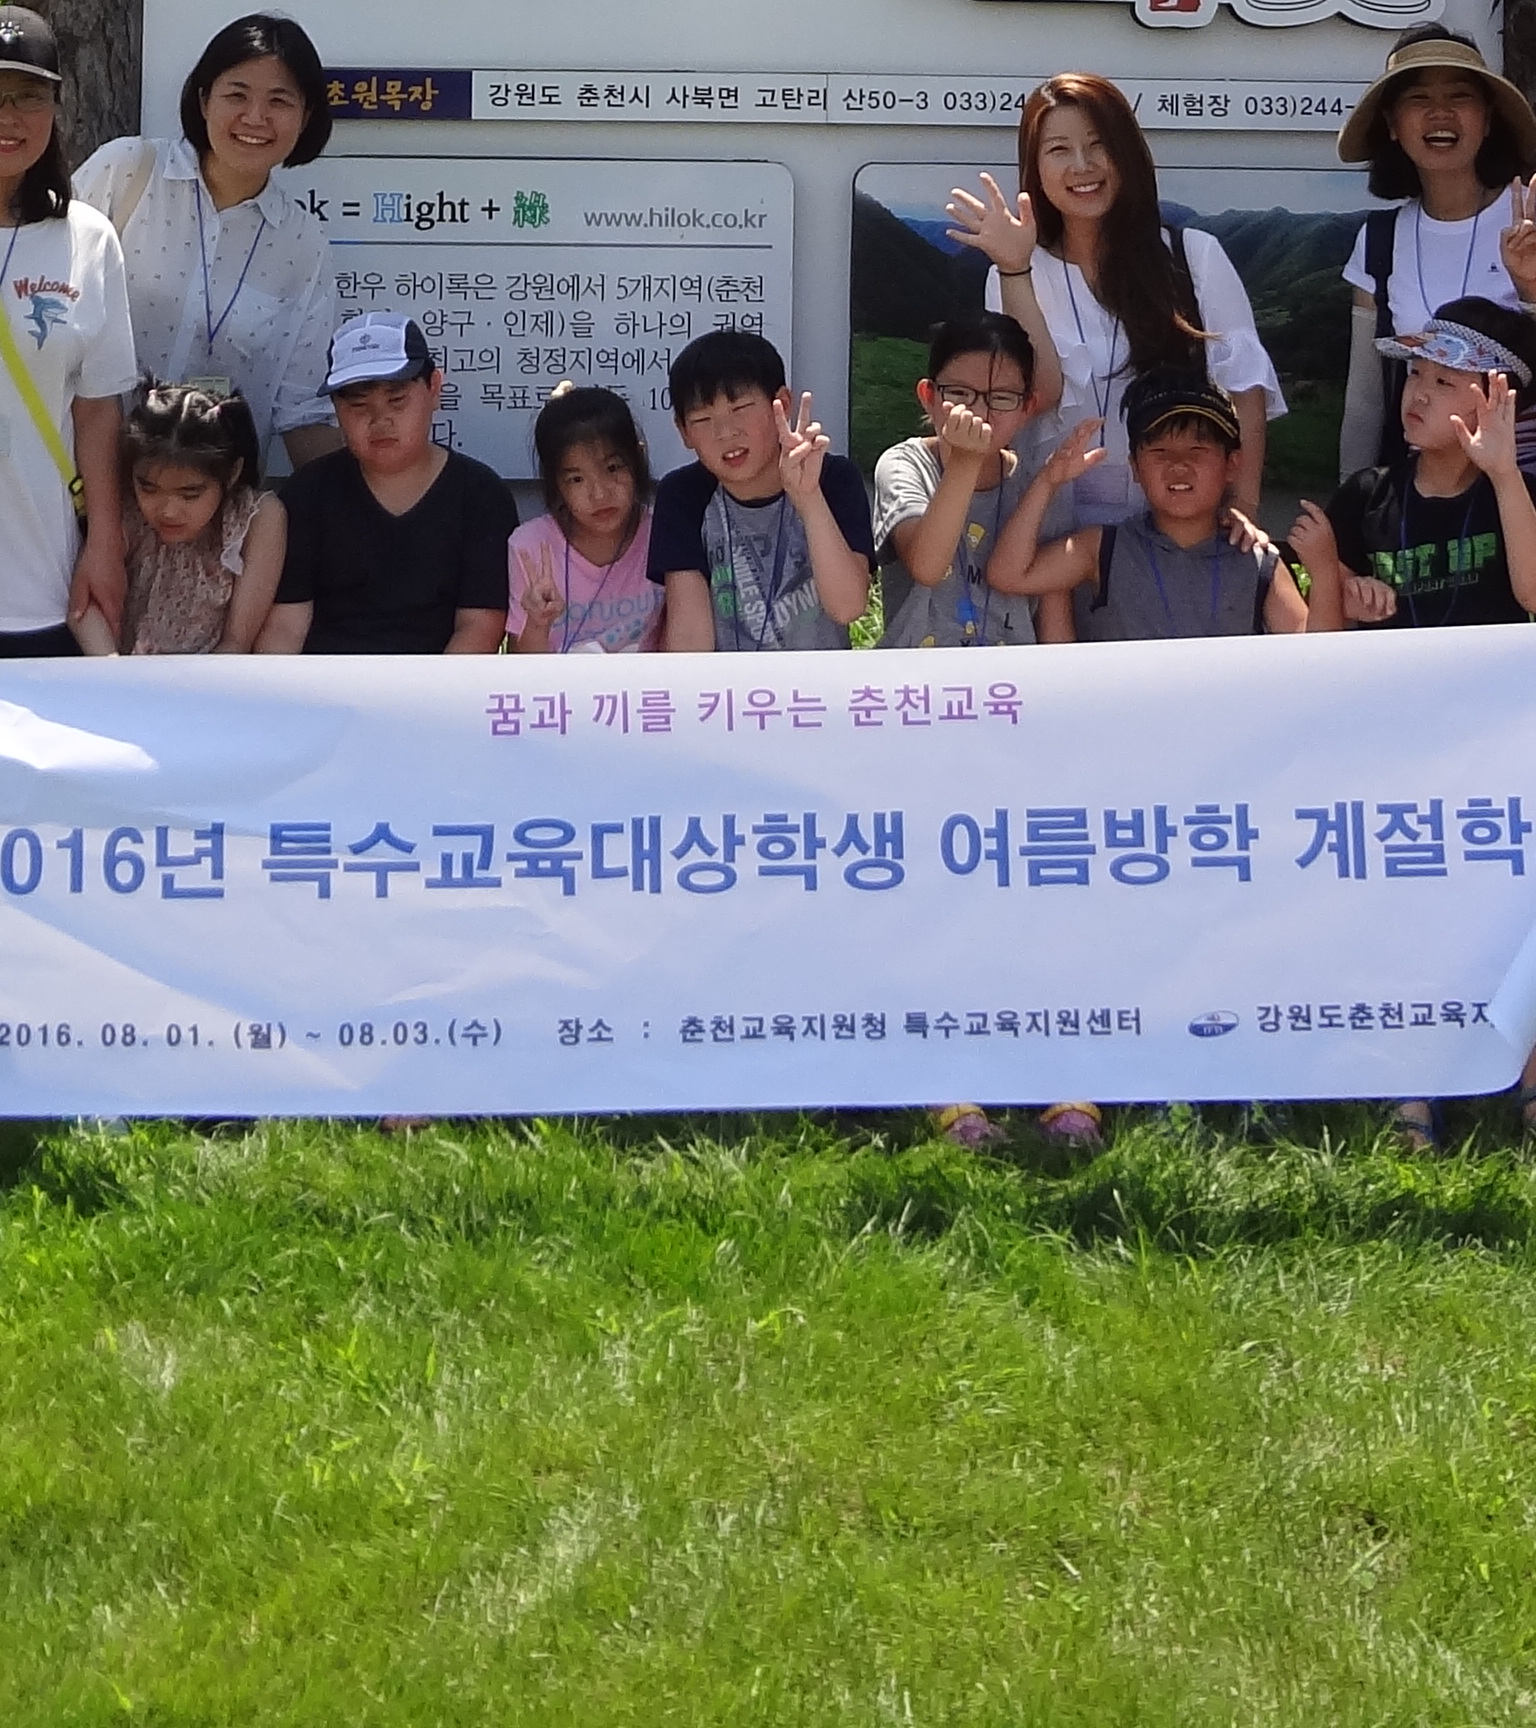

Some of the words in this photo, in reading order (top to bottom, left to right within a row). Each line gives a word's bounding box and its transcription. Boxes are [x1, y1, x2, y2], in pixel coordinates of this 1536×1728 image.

[327, 76, 439, 111] 초원목장
[489, 83, 562, 107] 강원도
[576, 83, 650, 109] 춘천시
[665, 85, 739, 110] 사북면
[754, 87, 828, 111] 고탄리
[842, 88, 929, 111] 산50-3
[1157, 93, 1231, 118] 체험장
[373, 190, 470, 231] Hight
[583, 206, 768, 230] www.hilok.co.kr
[13, 275, 81, 303] Welcome
[334, 271, 387, 301] 한우
[394, 271, 498, 301] 하이록은
[505, 272, 605, 303] 강원에서
[616, 274, 765, 304] 5개지역(춘천
[421, 310, 476, 338] 양구
[503, 309, 596, 339] 인제)을
[613, 310, 693, 340] 하나의
[514, 346, 672, 378] 청정지역에서
[485, 692, 573, 737] 꿈과
[592, 690, 677, 735] 끼를
[697, 689, 827, 732] 키우는
[847, 682, 1024, 728] 춘천교육
[261, 811, 906, 900] 특수교육대상학생
[940, 803, 1260, 888] 여름방학
[101, 1023, 149, 1048] 08.
[166, 1023, 214, 1047] 01.
[233, 1021, 287, 1050] (월)
[338, 1018, 502, 1047] 08.03.(수)
[557, 1017, 614, 1047] 장소
[679, 1012, 887, 1044] 춘천교육지원청
[903, 1007, 1142, 1040] 특수교육지원센터
